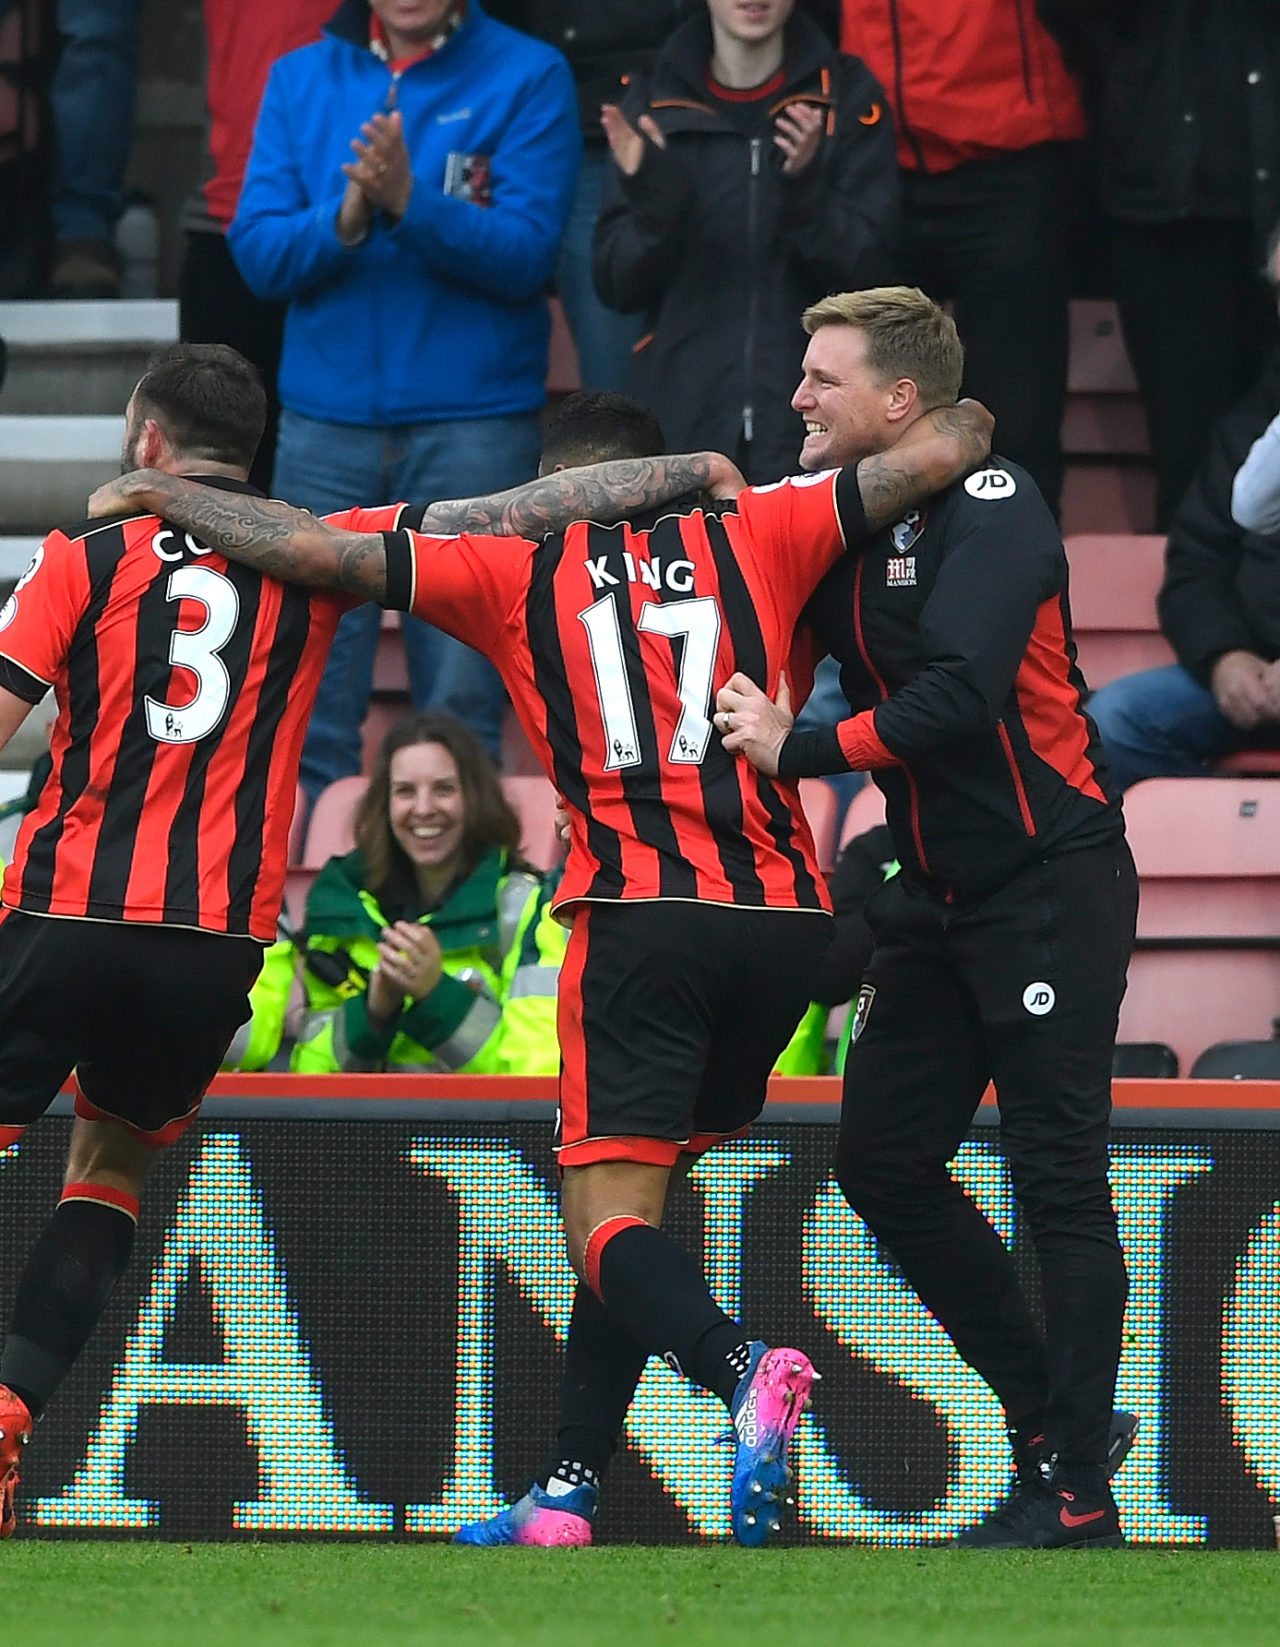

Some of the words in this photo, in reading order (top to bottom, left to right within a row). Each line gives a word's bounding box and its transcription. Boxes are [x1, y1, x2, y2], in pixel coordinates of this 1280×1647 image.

[977, 474, 1007, 491] JD
[152, 530, 214, 562] CO
[584, 552, 696, 592] KING
[144, 565, 240, 744] 3
[577, 591, 722, 772] 17
[1030, 992, 1050, 1006] JD
[743, 1388, 758, 1448] adidas
